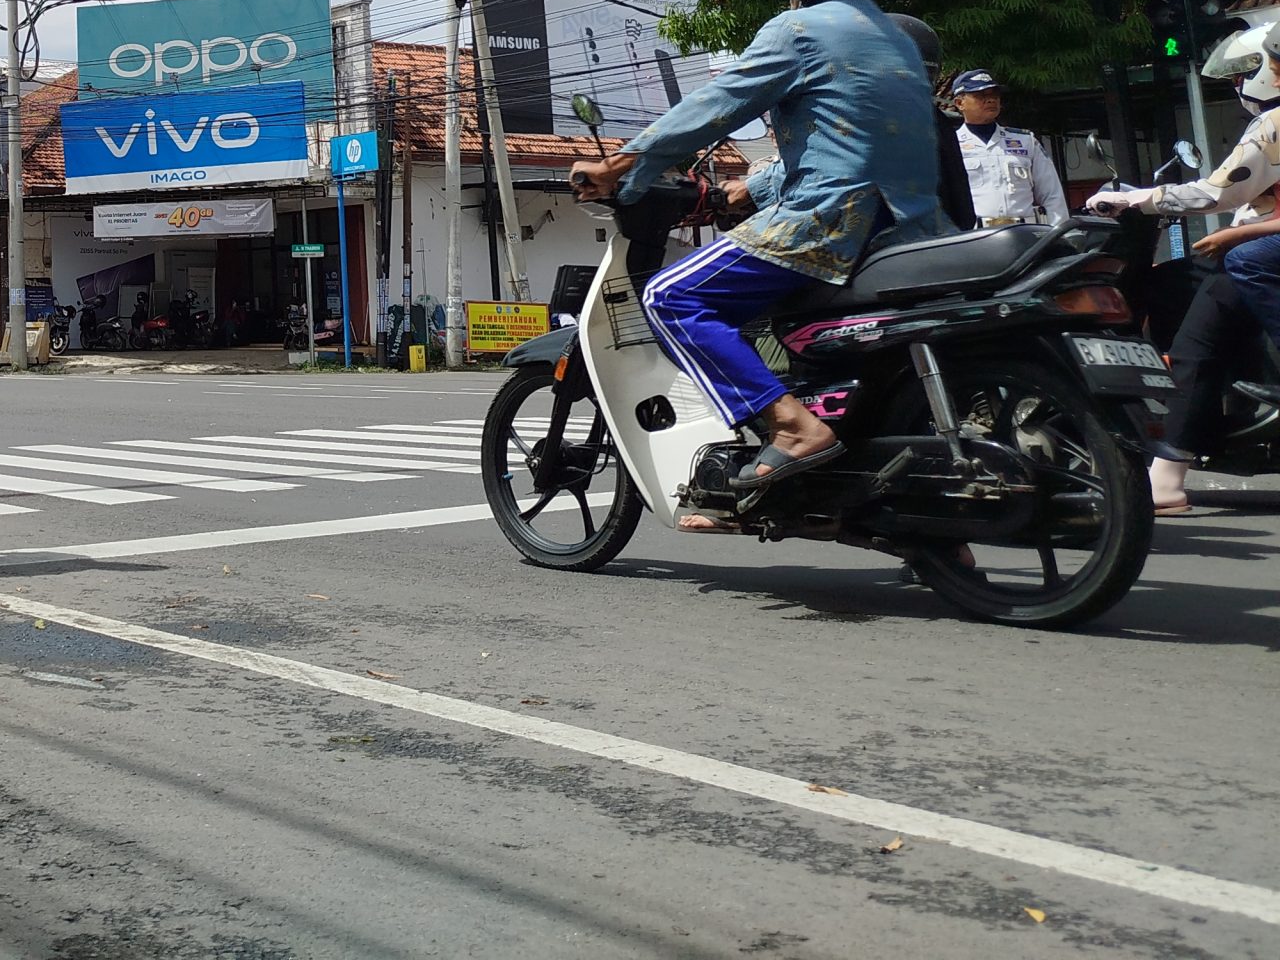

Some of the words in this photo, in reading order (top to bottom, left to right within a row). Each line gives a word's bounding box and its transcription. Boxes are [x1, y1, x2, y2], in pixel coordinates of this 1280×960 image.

[488, 35, 540, 50] AMSUNG
[95, 107, 260, 159] vivo
[348, 141, 359, 162] hp
[150, 170, 207, 184] IMAGO
[168, 206, 201, 228] 40
[201, 208, 214, 218] GB
[478, 315, 537, 324] PEMBERITAHUAN
[1079, 342, 1096, 365] B
[796, 395, 823, 405] NDA
